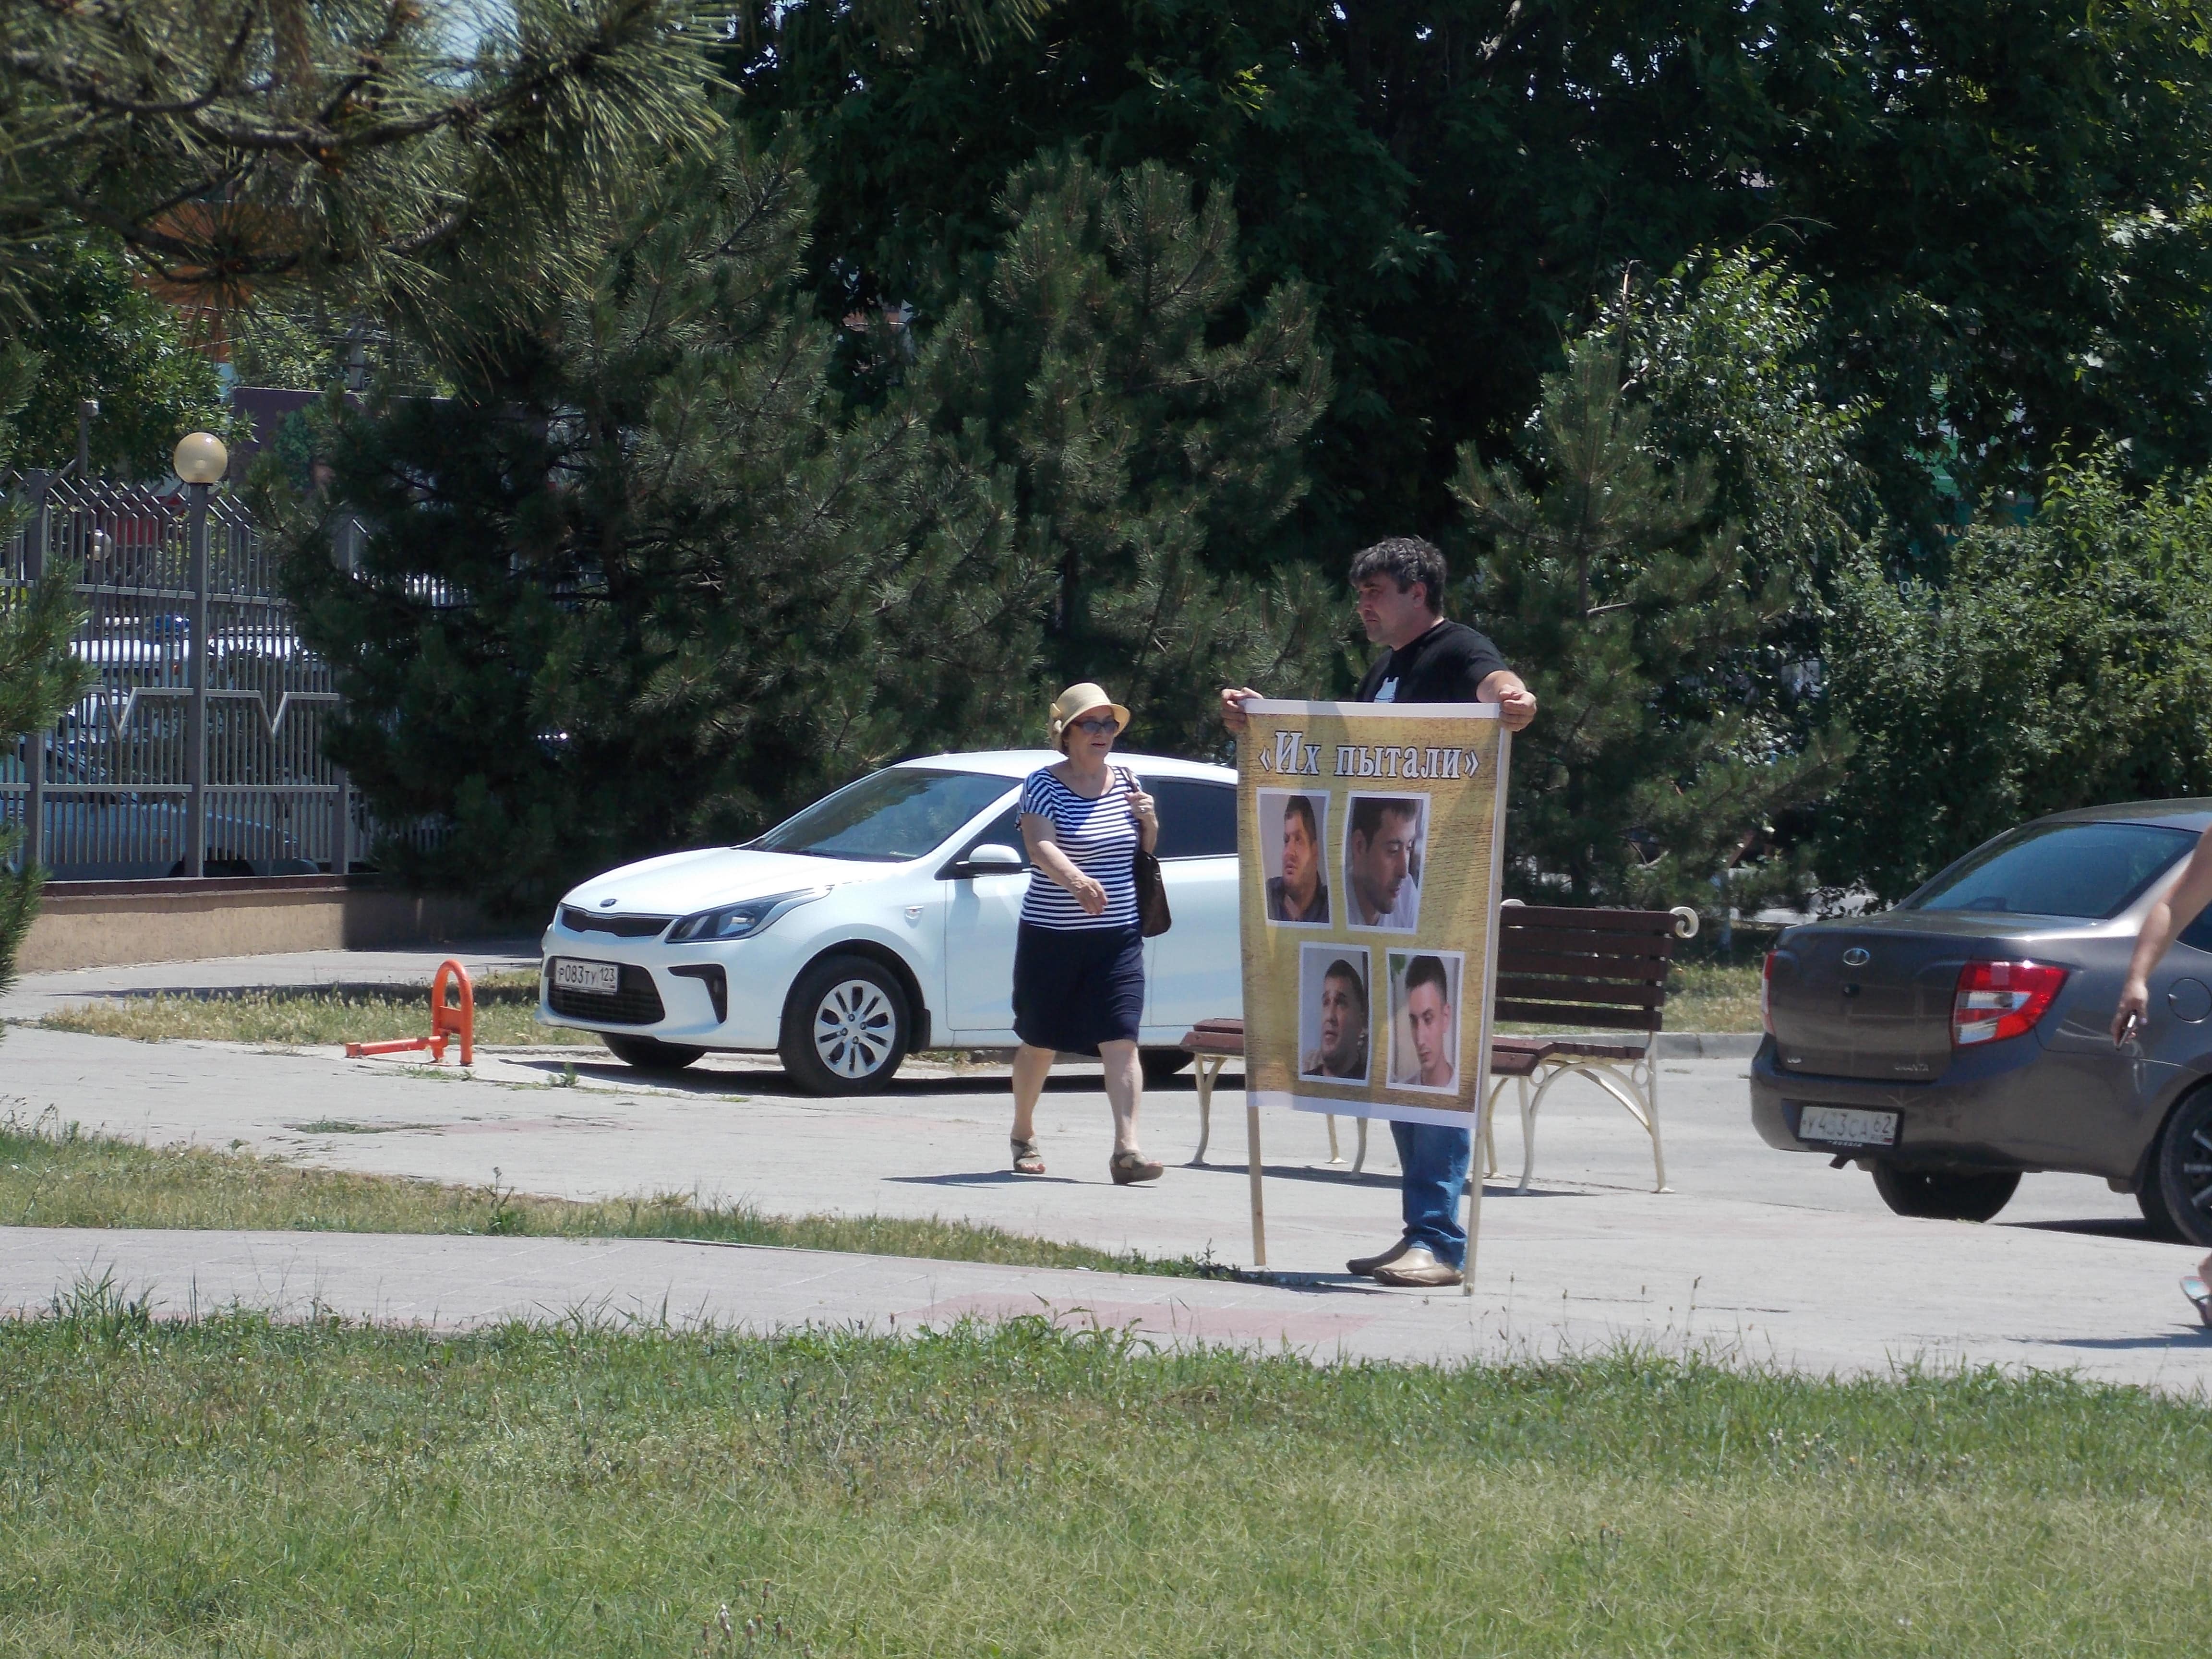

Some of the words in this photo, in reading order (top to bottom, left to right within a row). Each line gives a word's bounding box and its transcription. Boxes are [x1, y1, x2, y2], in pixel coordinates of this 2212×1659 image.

[1258, 730, 1321, 776] «Их
[1334, 745, 1481, 780] пытали»
[600, 967, 615, 982] 123
